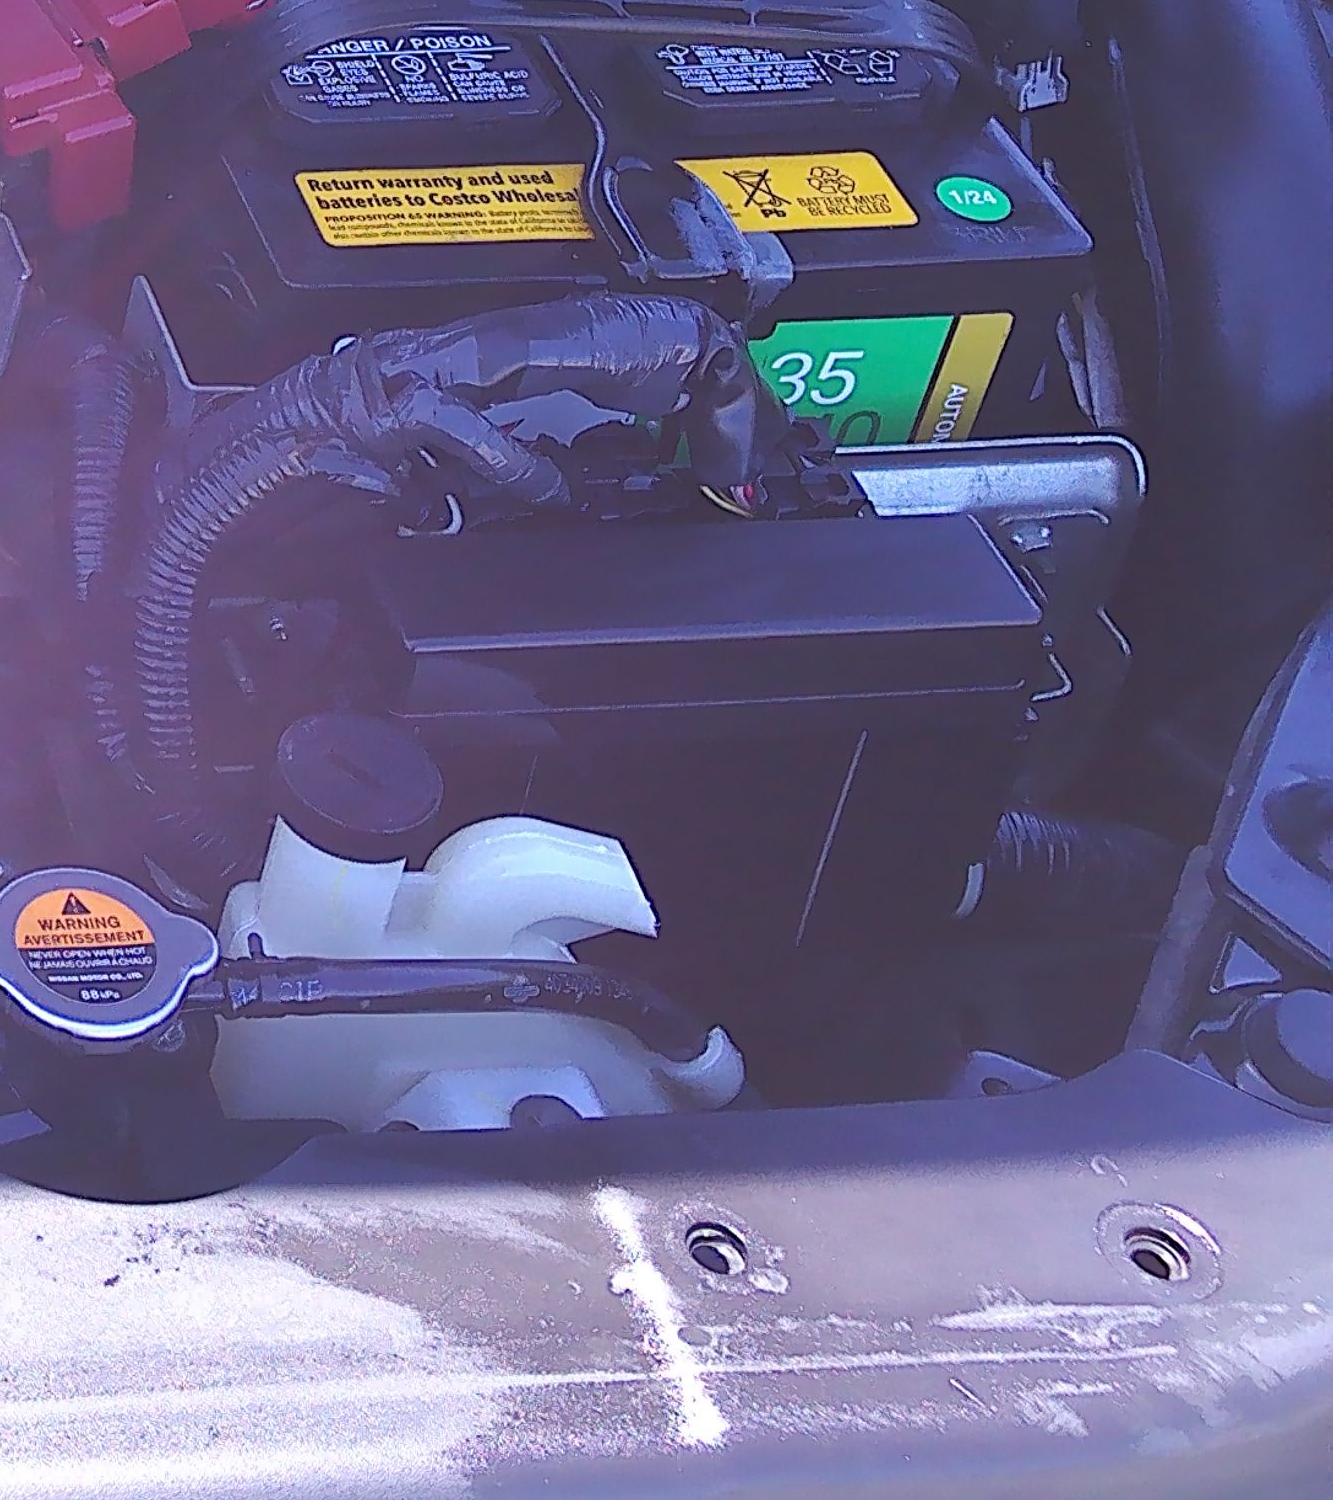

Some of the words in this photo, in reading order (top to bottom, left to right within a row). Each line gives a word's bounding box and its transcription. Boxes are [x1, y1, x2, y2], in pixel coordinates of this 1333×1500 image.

[410, 34, 493, 50] POISON
[405, 74, 424, 84] NO
[307, 177, 375, 192] Return
[379, 174, 464, 192] warranty
[468, 171, 505, 187] and
[508, 170, 554, 186] used
[316, 193, 403, 210] batteries
[405, 193, 427, 208] to
[430, 190, 491, 207] Costco
[492, 187, 583, 204] Wholesal
[796, 195, 853, 208] BATTERY
[853, 192, 890, 205] MUST
[948, 189, 999, 206] 1/24
[323, 213, 406, 223] PROPOSITION
[408, 212, 423, 221] 65
[425, 210, 487, 220] WARNING:
[761, 207, 788, 218] Pb
[808, 205, 827, 218] BE
[827, 202, 893, 217] RECYCLED
[771, 350, 865, 406] 35
[36, 915, 121, 931] WARNING
[23, 929, 146, 946] AVERTISSEMENT
[28, 948, 62, 959] NEVER
[63, 948, 91, 959] OPEN
[92, 947, 125, 958] WHEN
[125, 946, 146, 956] HOT
[28, 959, 42, 970] NE
[43, 958, 75, 969] JAMAIS
[118, 955, 153, 967] CHAUD
[48, 974, 79, 983] NISSAN
[80, 973, 110, 982] MOTOR
